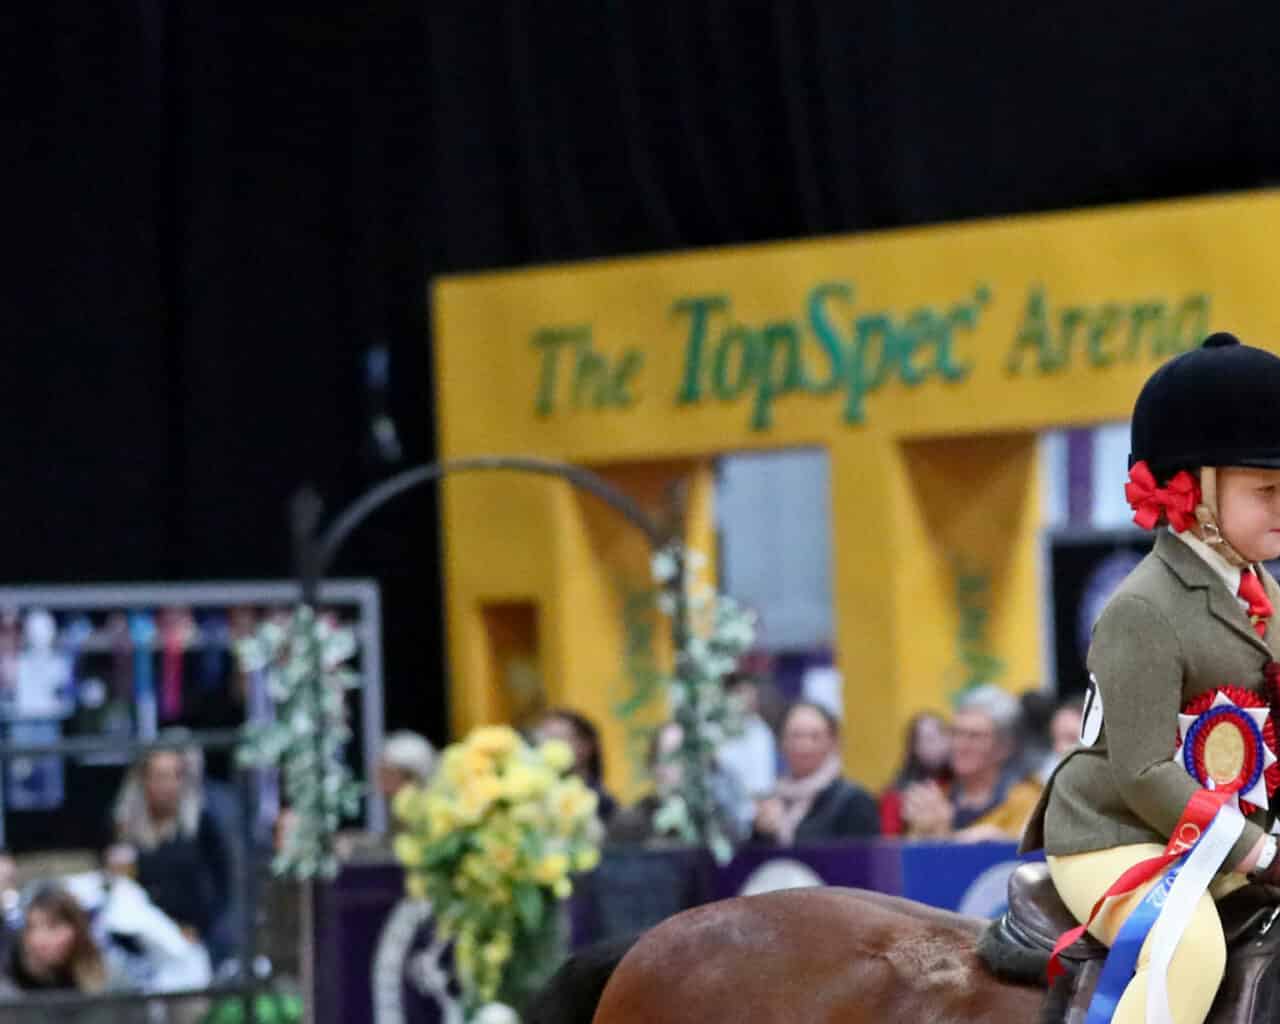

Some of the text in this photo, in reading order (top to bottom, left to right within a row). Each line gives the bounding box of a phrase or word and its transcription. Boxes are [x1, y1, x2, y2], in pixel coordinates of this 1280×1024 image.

[530, 281, 1210, 432] The TopSpec Arena
